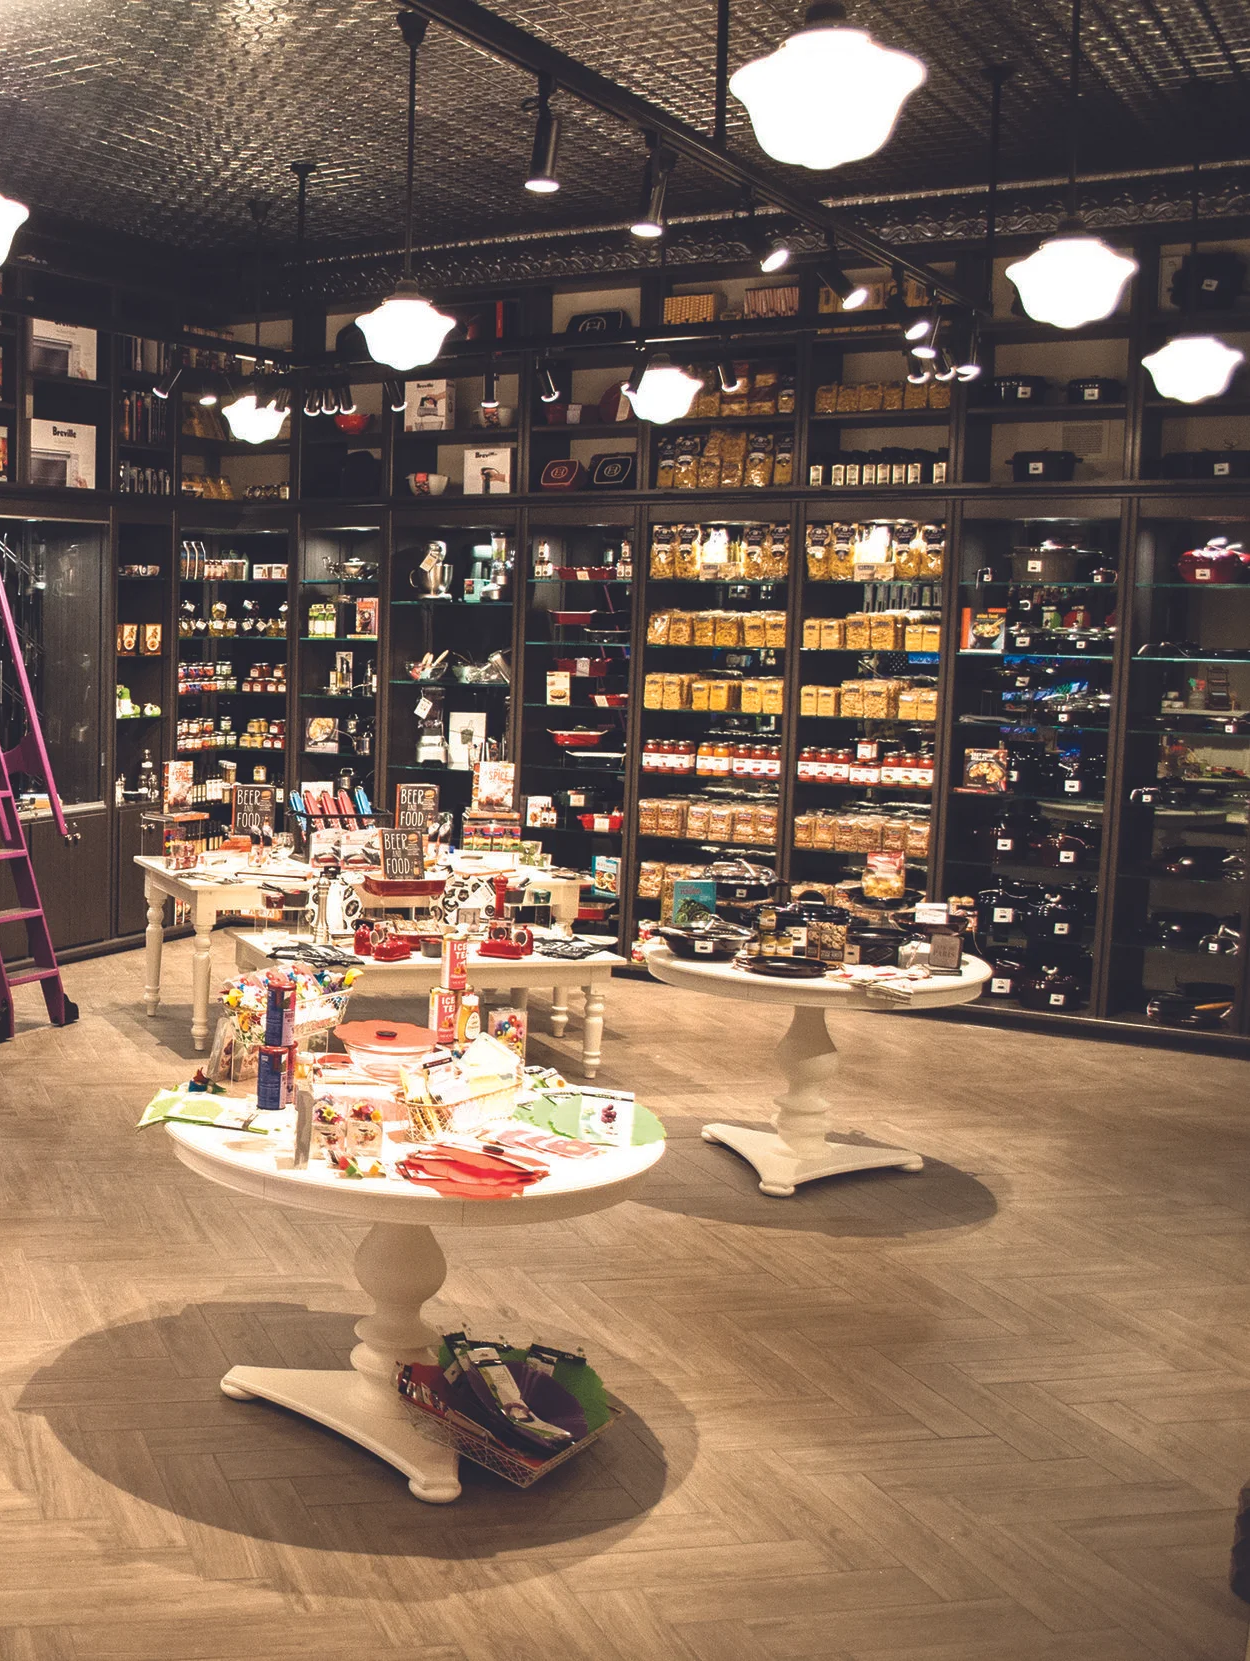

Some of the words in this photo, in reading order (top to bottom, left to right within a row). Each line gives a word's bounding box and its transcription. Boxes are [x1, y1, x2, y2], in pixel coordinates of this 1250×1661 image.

[52, 426, 77, 438] Breville
[488, 771, 509, 781] SPICE
[237, 789, 261, 806] BEER
[400, 788, 424, 805] BEER
[237, 812, 261, 828] FOOD
[400, 811, 424, 827] FOOD
[384, 833, 408, 850] BEER
[386, 858, 410, 874] FOOD
[453, 943, 467, 951] ICE
[441, 996, 455, 1005] ICE
